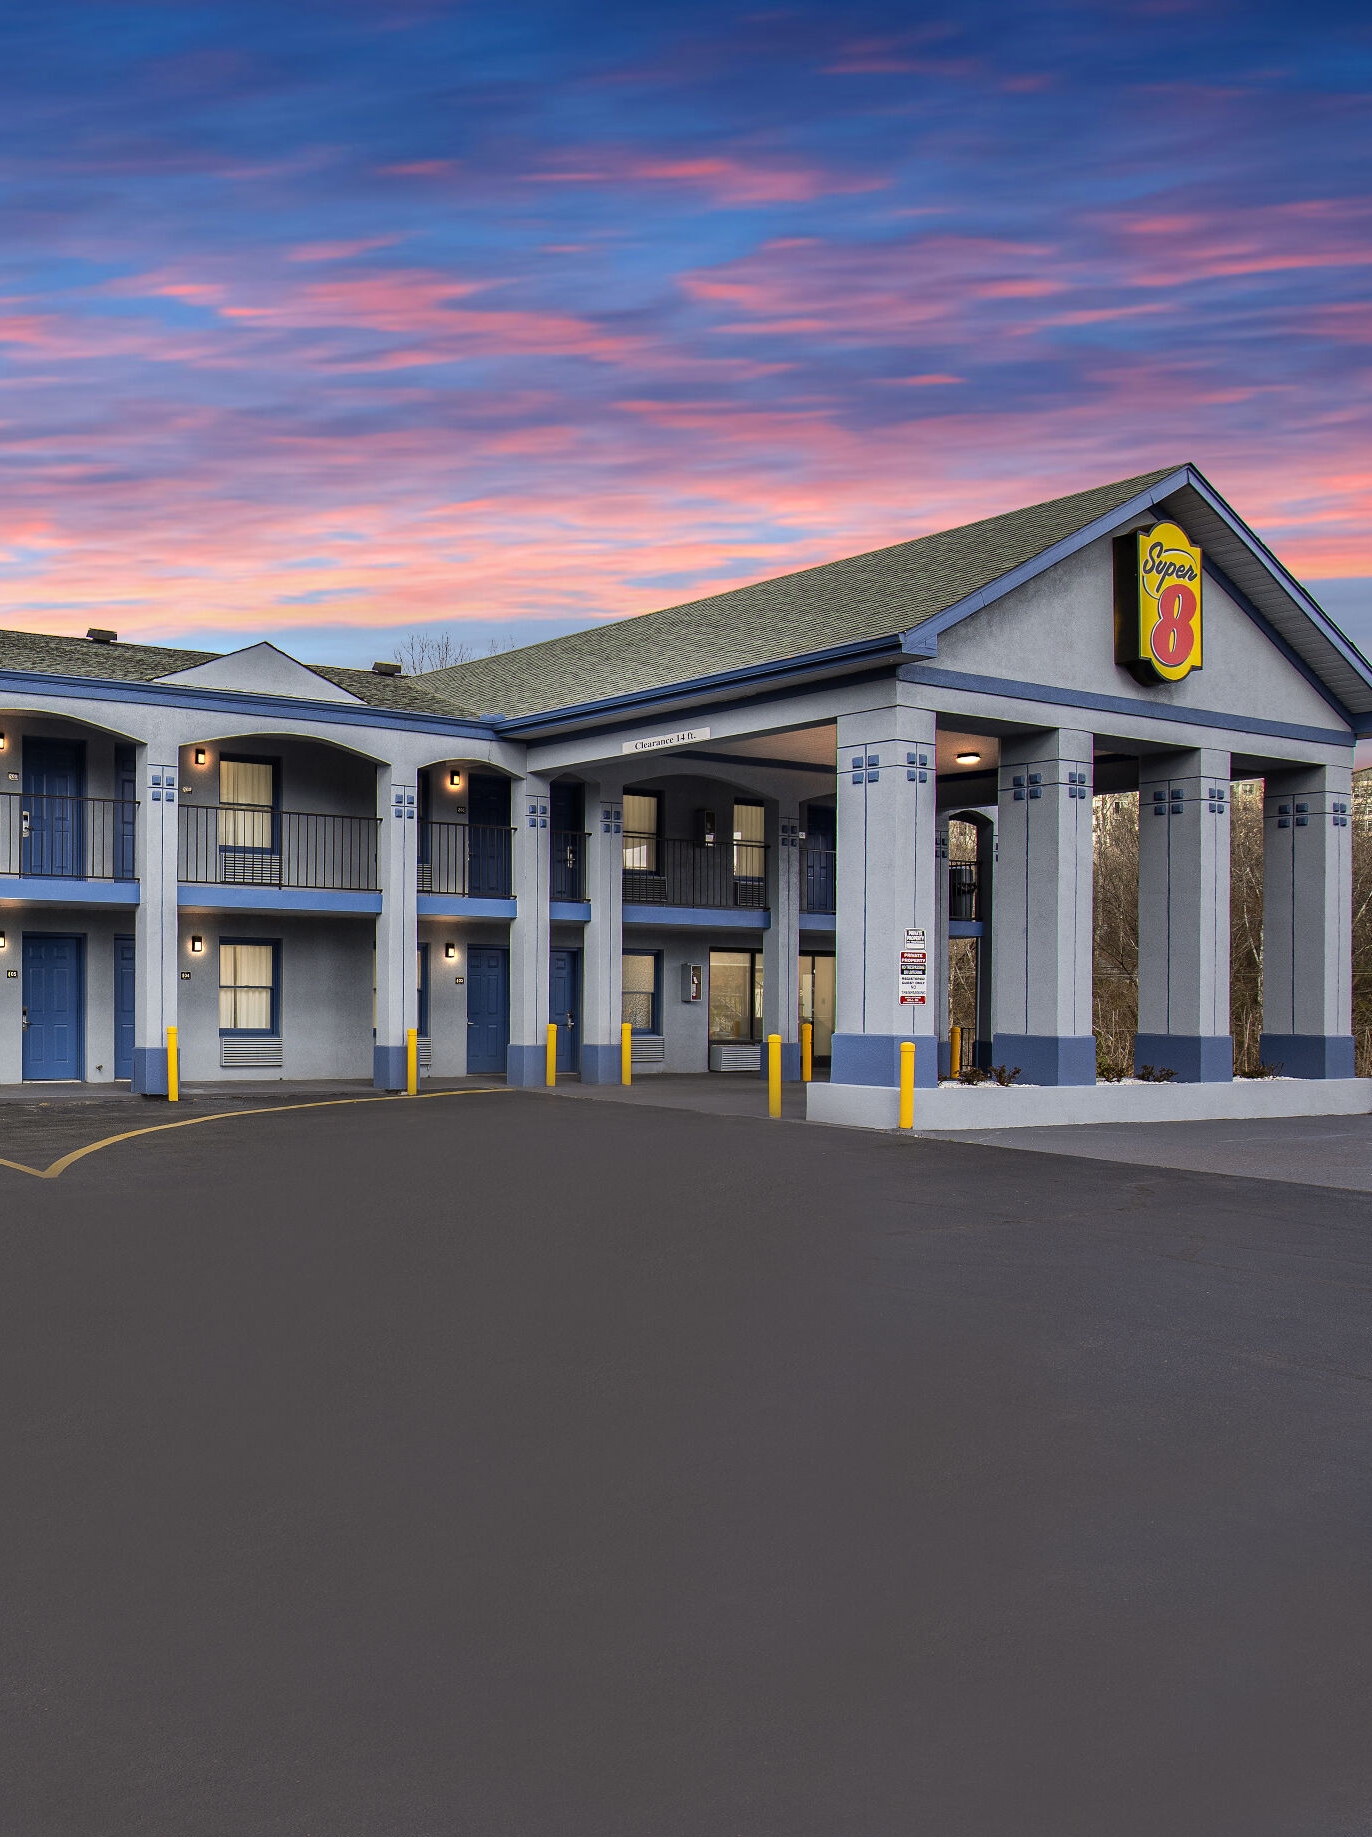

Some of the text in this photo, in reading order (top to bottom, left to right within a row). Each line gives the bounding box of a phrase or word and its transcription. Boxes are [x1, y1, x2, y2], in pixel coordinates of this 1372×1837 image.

[1142, 541, 1198, 594] Super
[1150, 583, 1197, 668] 8
[634, 731, 696, 750] Clearance 14 ft.
